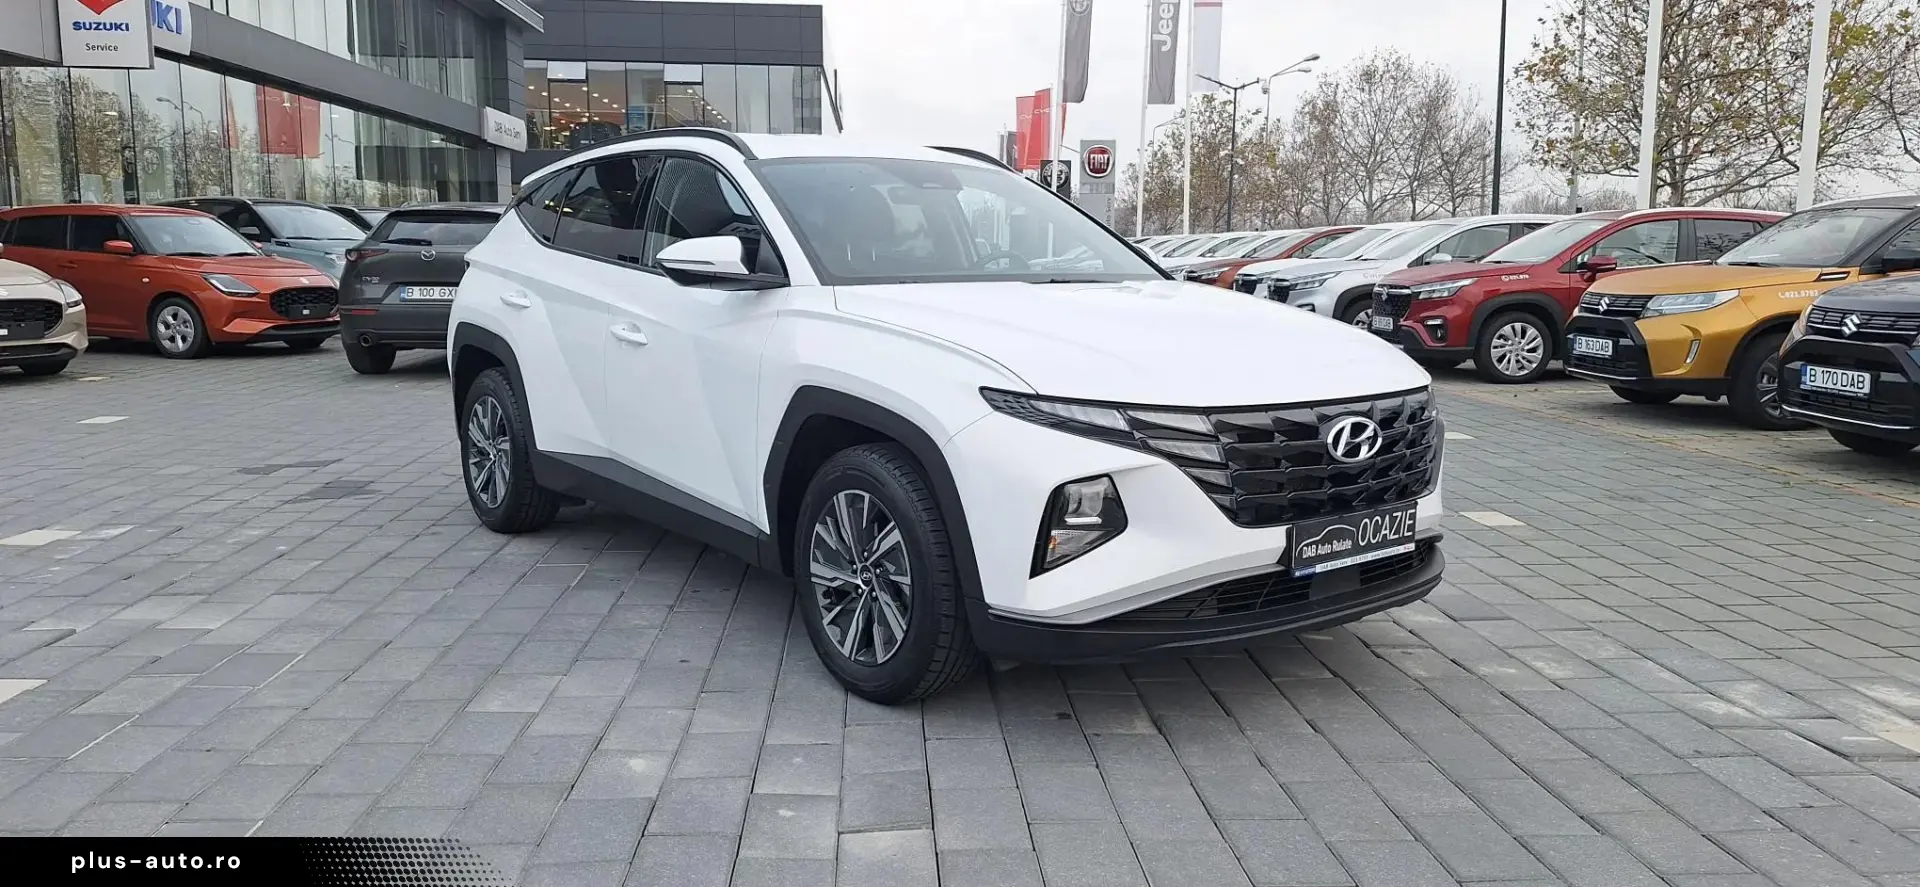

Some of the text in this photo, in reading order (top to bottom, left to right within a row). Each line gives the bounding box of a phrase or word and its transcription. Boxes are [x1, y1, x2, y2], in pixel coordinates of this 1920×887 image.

[72, 21, 130, 32] SUZUKI
[85, 43, 119, 52] Service
[1090, 153, 1109, 169] FIAT
[406, 287, 414, 298] B
[419, 287, 435, 298] 100
[1577, 337, 1583, 349] B
[1595, 340, 1610, 353] DAB
[1809, 368, 1866, 390] B 170 DAB
[1358, 509, 1416, 546] OCAZIE
[1302, 538, 1353, 558] DAB Auto Rulate
